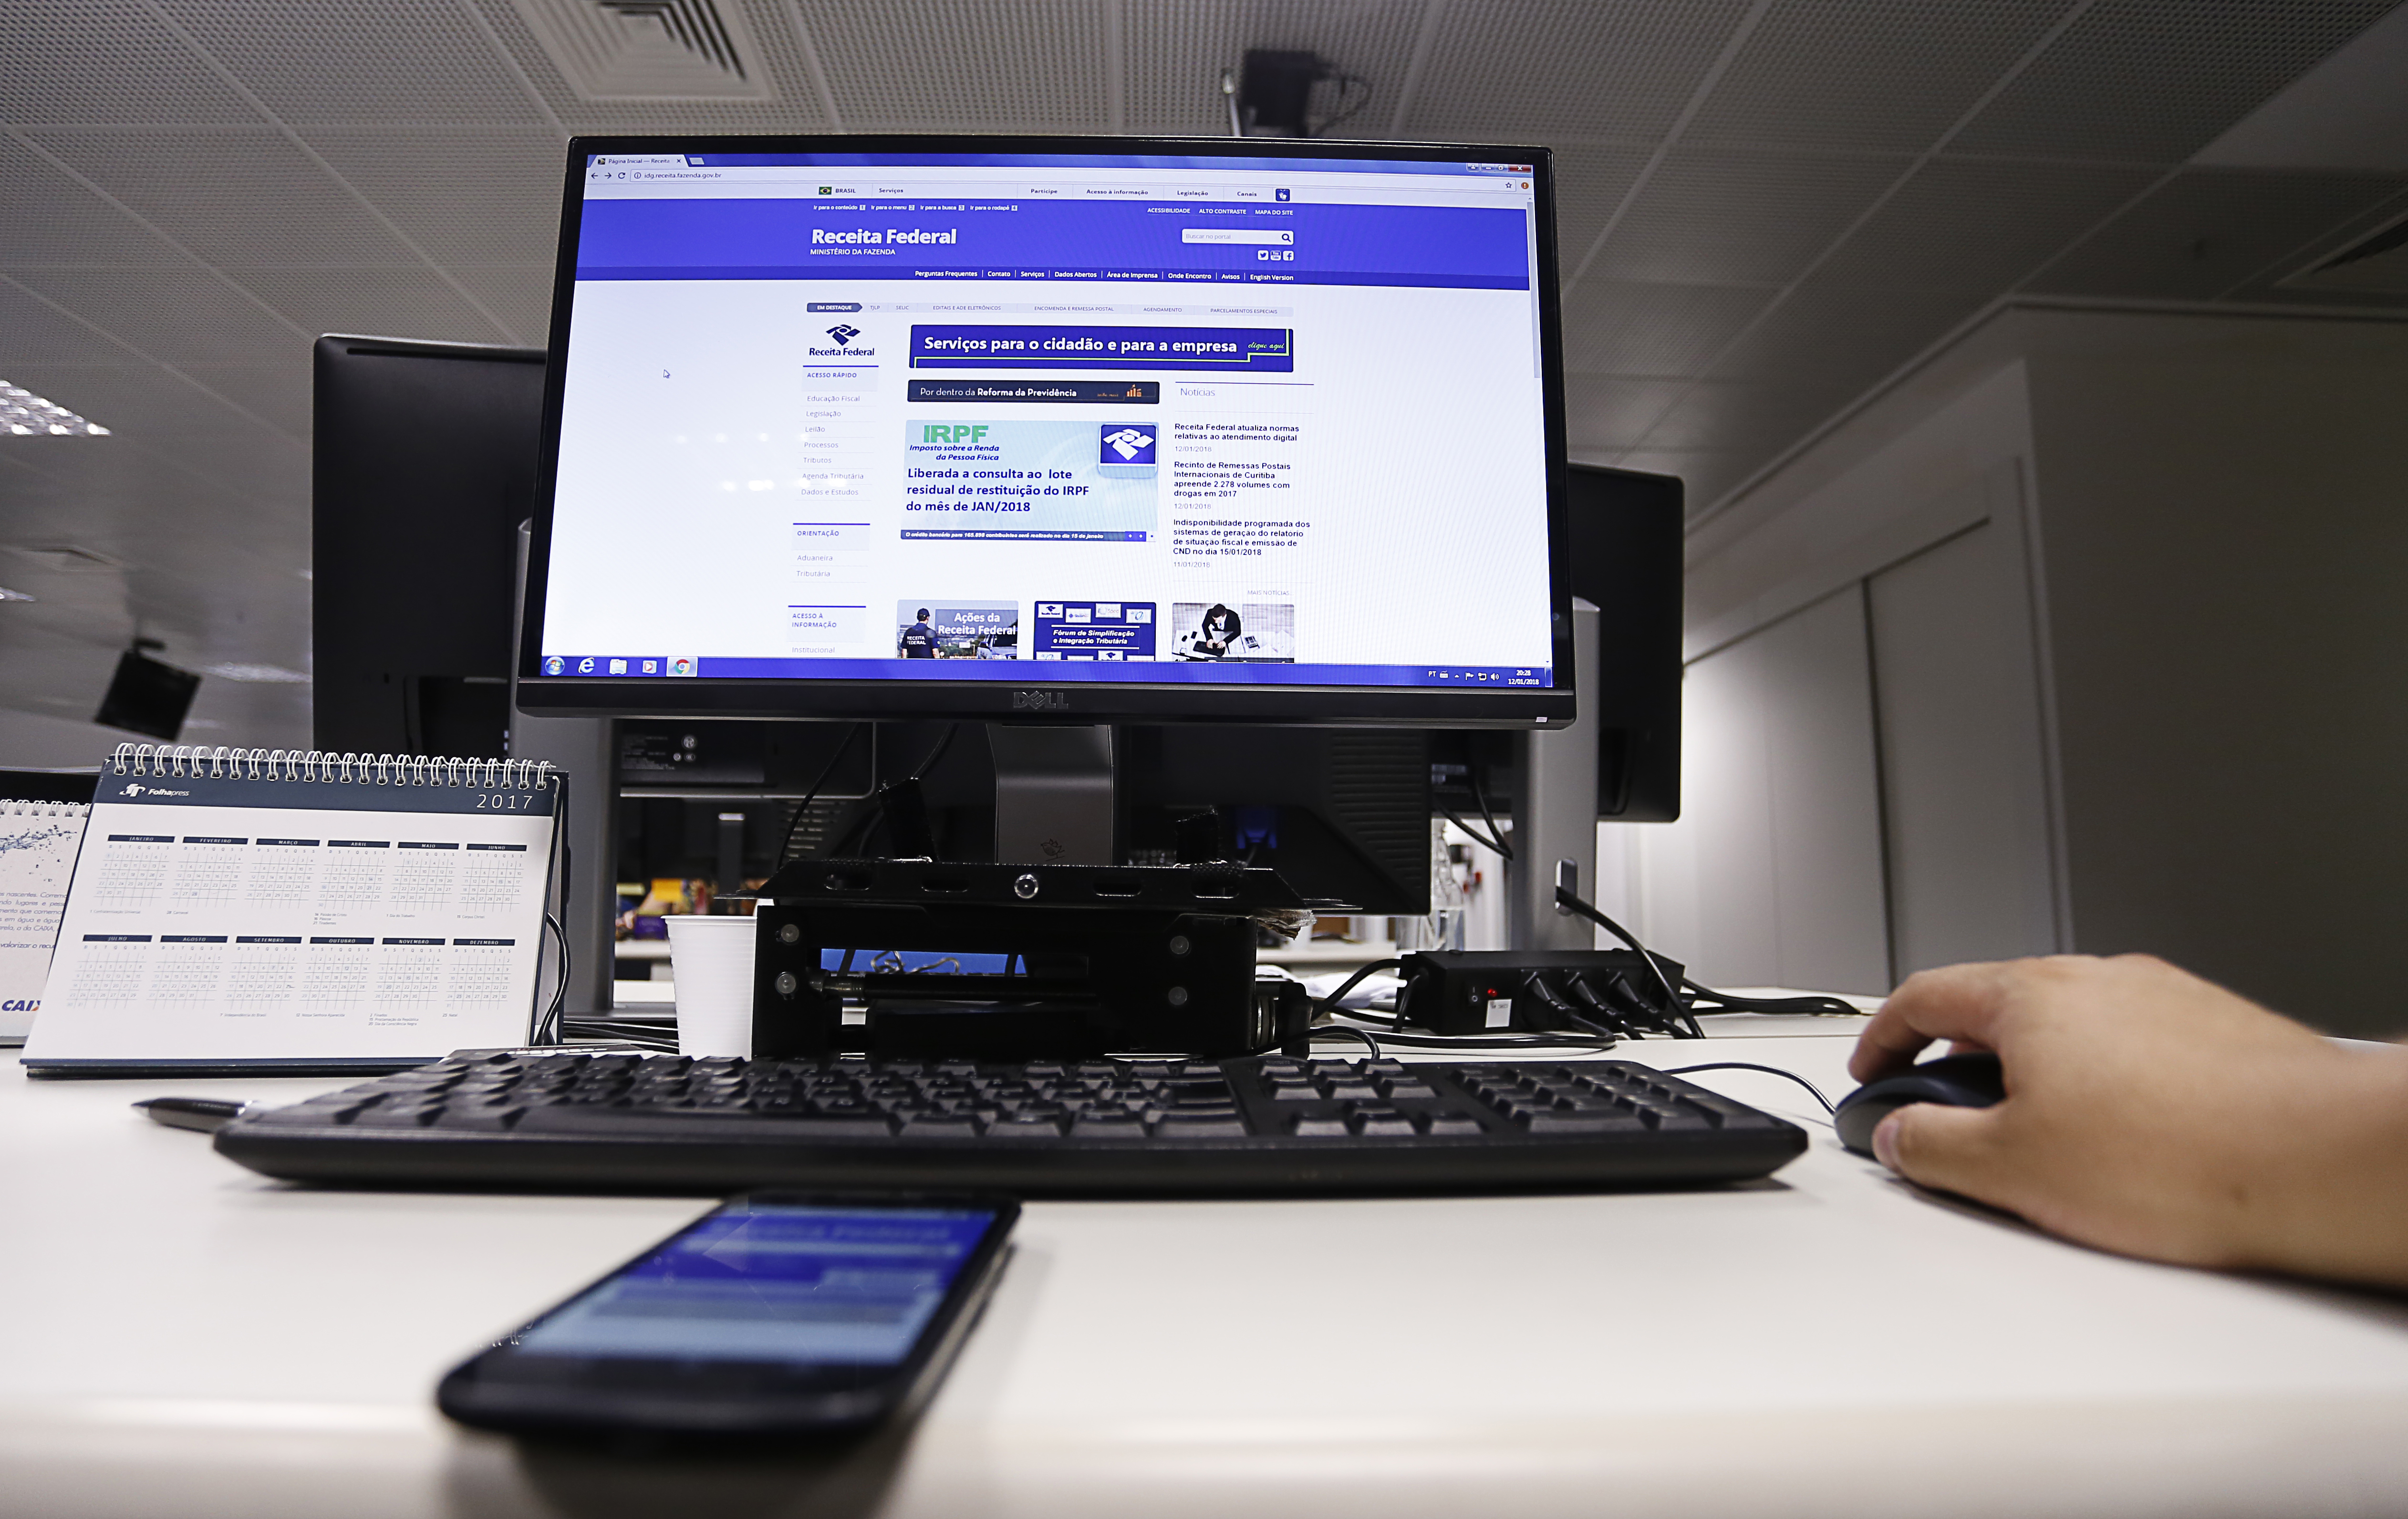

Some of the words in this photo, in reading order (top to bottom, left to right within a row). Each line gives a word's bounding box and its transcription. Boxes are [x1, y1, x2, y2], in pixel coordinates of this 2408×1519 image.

[812, 229, 882, 244] Receita
[887, 229, 957, 244] Federal
[924, 337, 987, 353] Serviços
[991, 340, 1025, 353] para
[1029, 341, 1039, 350] o
[1043, 337, 1104, 351] cidadão
[1107, 341, 1117, 351] e
[1121, 341, 1155, 354] para
[1159, 342, 1168, 351] a
[1172, 342, 1237, 355] empresa
[1248, 342, 1267, 351] clique
[1269, 343, 1284, 351] aqui
[977, 387, 1013, 396] Reforma
[1015, 388, 1025, 396] da
[1028, 388, 1077, 396] Previdência
[1181, 388, 1215, 396] Notícias
[924, 425, 989, 443] IRPF
[908, 468, 958, 478] Liberada
[973, 468, 1023, 478] consulta
[1049, 469, 1072, 479] lote
[907, 485, 954, 494] residual
[958, 485, 973, 494] de
[977, 485, 1040, 497] restituição
[1044, 486, 1059, 495] do
[1063, 486, 1089, 495] IRPF
[906, 501, 921, 510] do
[925, 501, 949, 510] mês
[954, 501, 968, 511] de
[971, 501, 1030, 513] JAN/2018
[954, 613, 985, 624] Ações
[986, 613, 1000, 622] da
[938, 625, 975, 635] Receita
[978, 625, 1016, 635] Federal
[1013, 690, 1069, 709] DELL
[148, 789, 189, 797] Folhapress
[477, 794, 532, 809] 2017
[18, 916, 34, 925] água
